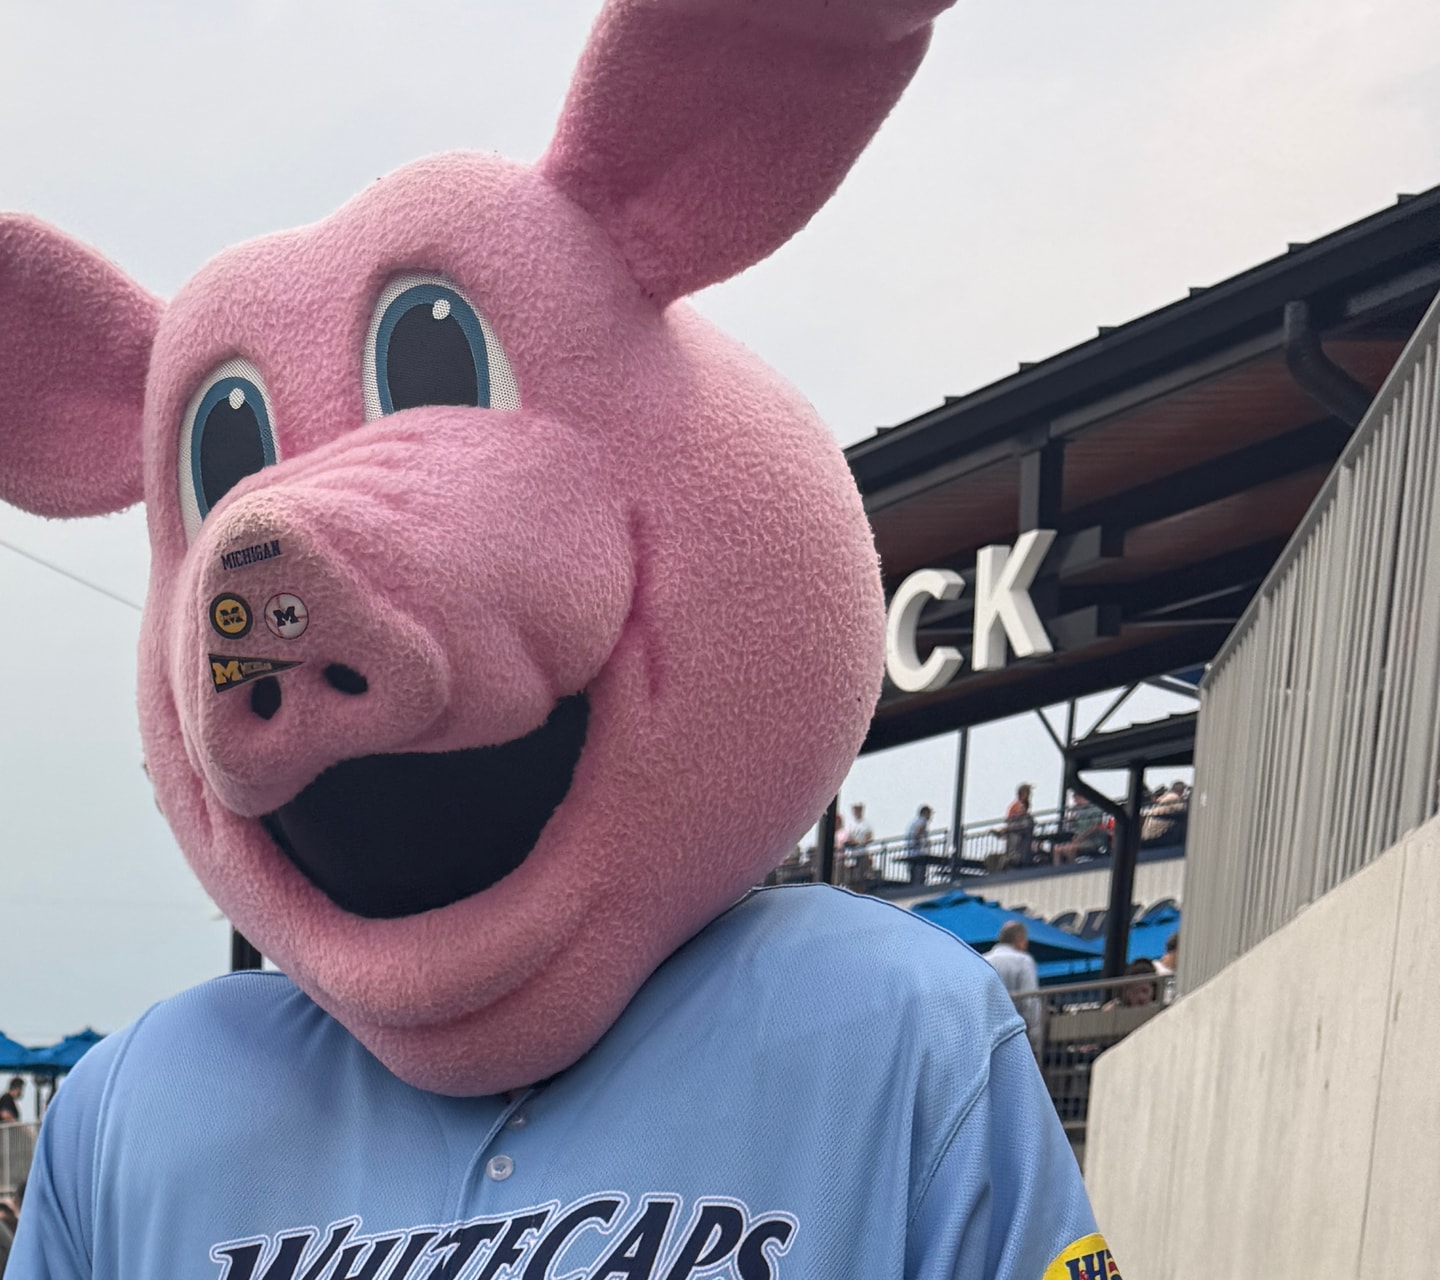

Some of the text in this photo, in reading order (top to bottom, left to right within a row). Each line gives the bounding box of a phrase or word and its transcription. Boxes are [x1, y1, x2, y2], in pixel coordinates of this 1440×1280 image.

[221, 540, 282, 570] MICHIGAN
[273, 606, 300, 627] M
[212, 660, 243, 685] M
